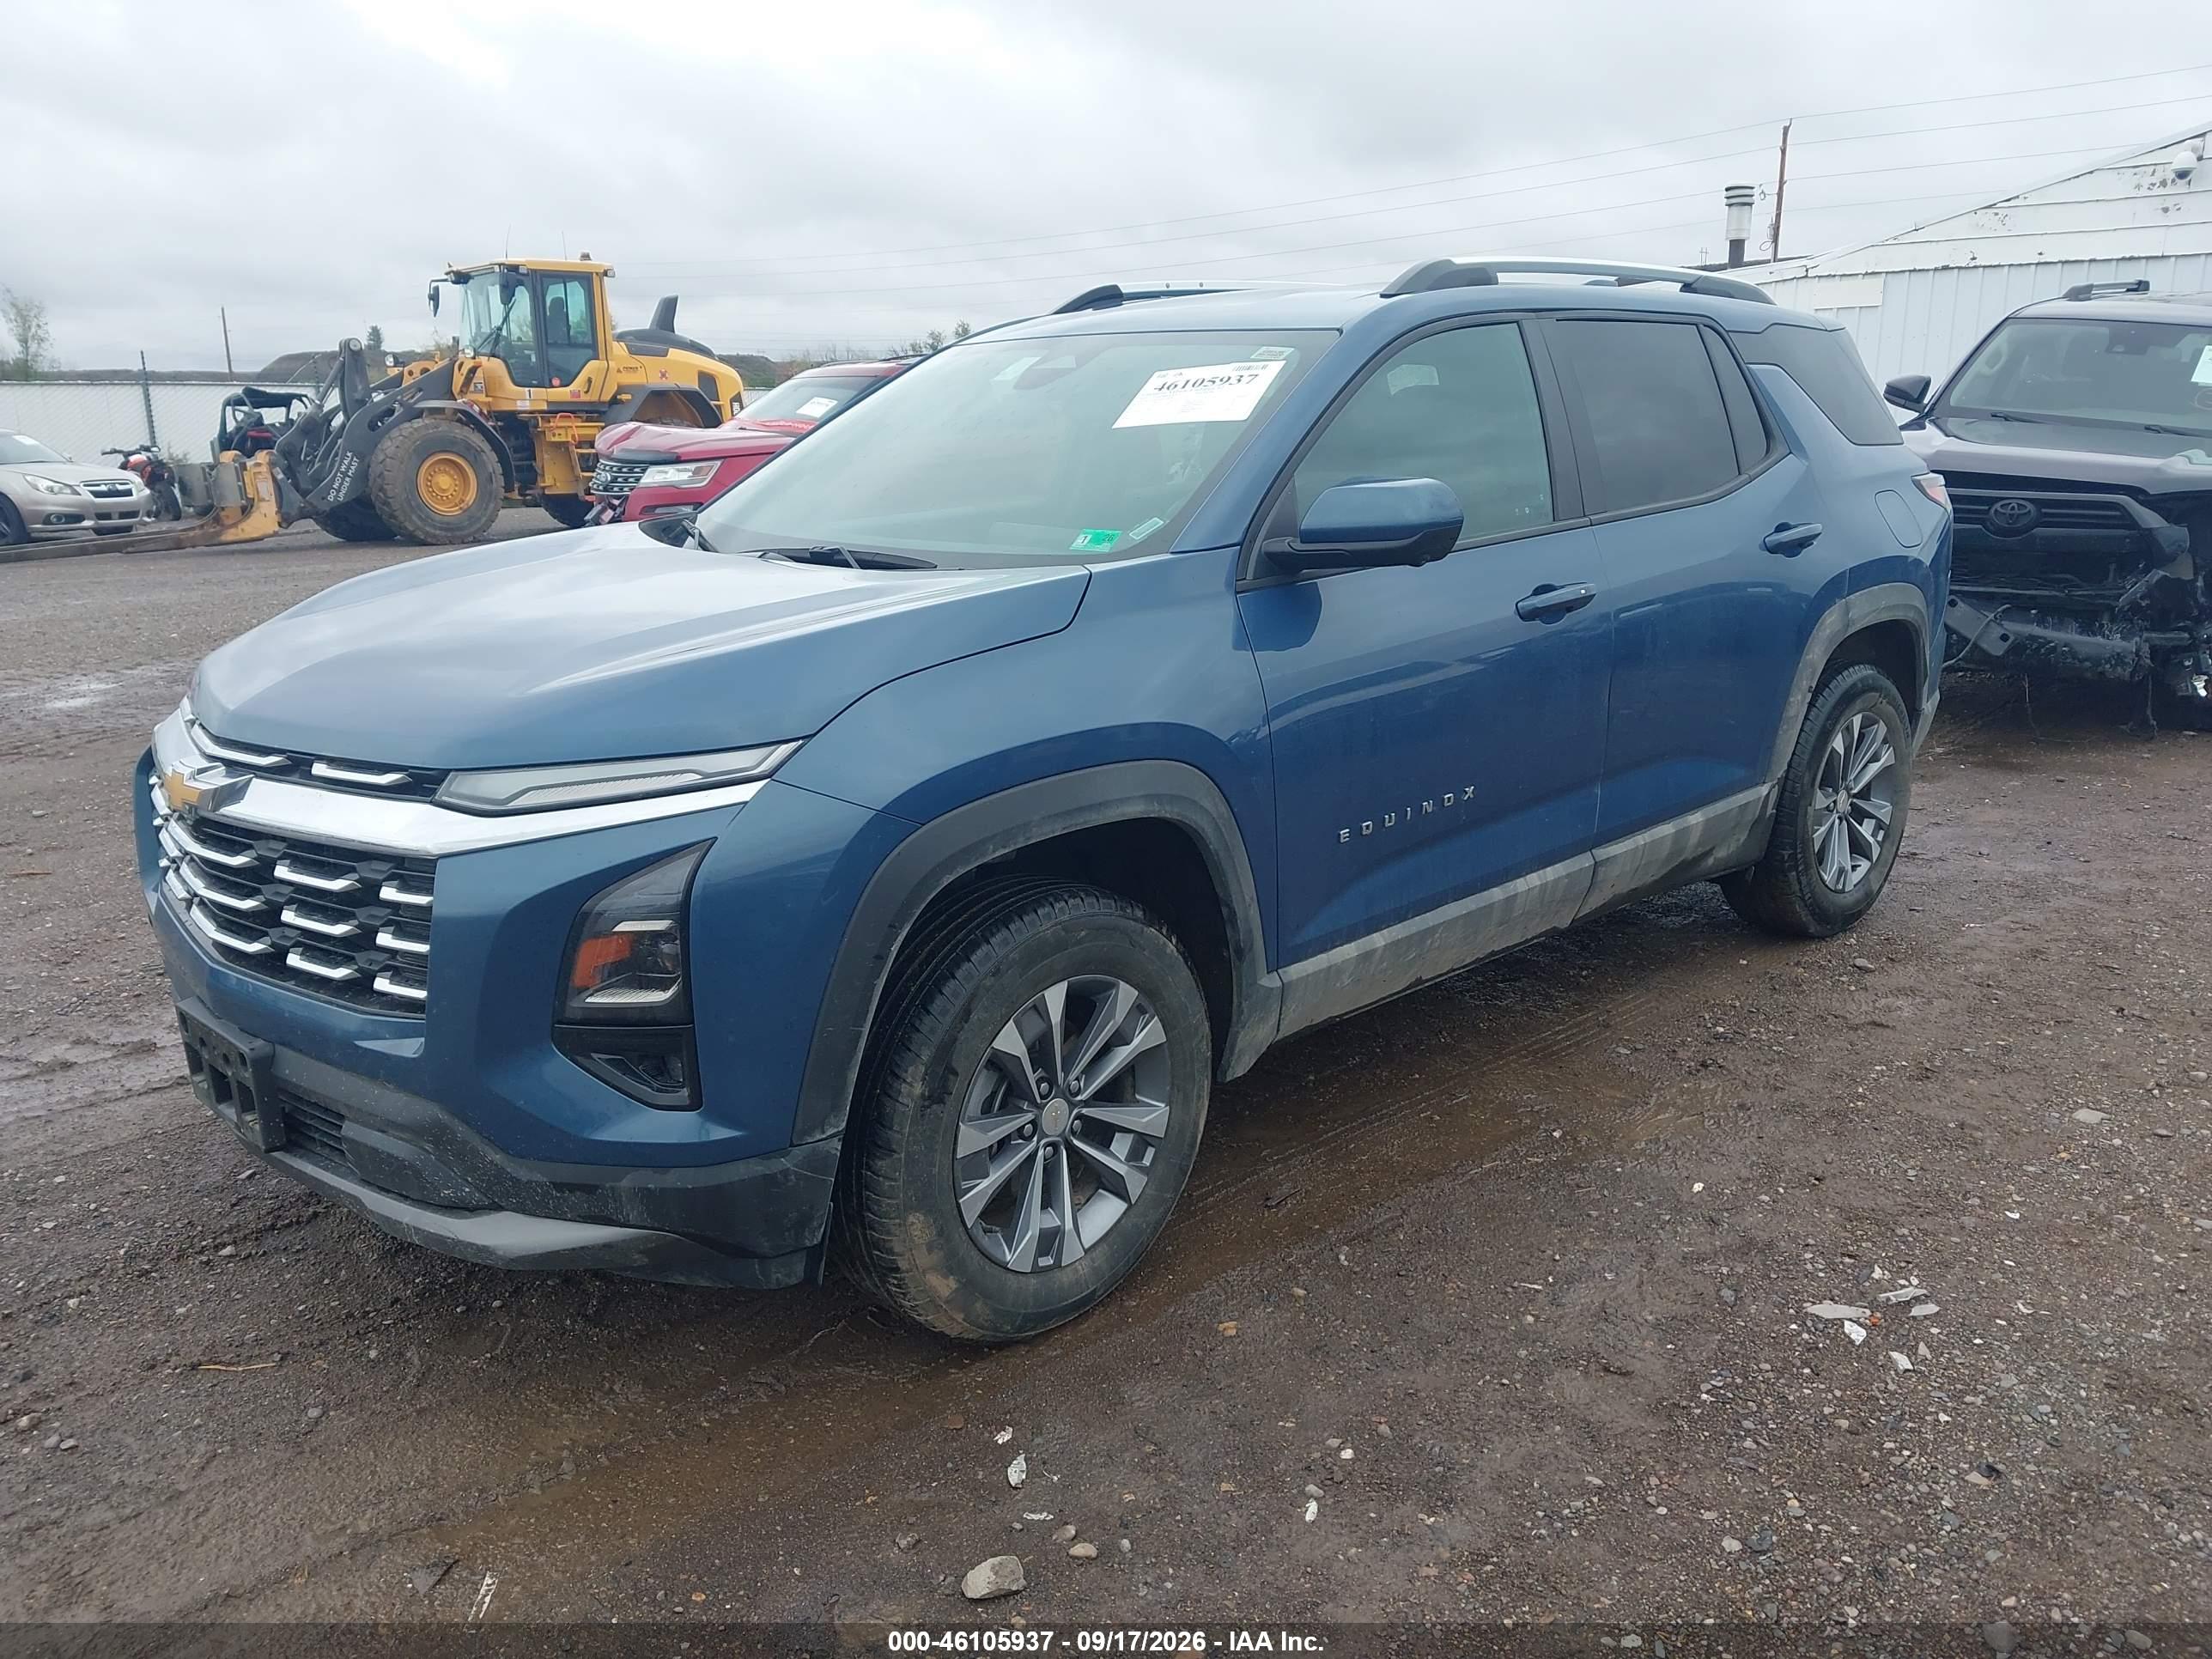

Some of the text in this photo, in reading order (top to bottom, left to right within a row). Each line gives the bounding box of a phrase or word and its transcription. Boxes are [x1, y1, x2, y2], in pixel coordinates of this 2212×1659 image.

[1154, 374, 1260, 392] 46105937
[327, 451, 353, 501] DO NOT WALK
[337, 456, 360, 501] UNDER MAST
[1338, 786, 1476, 844] EQUINOX
